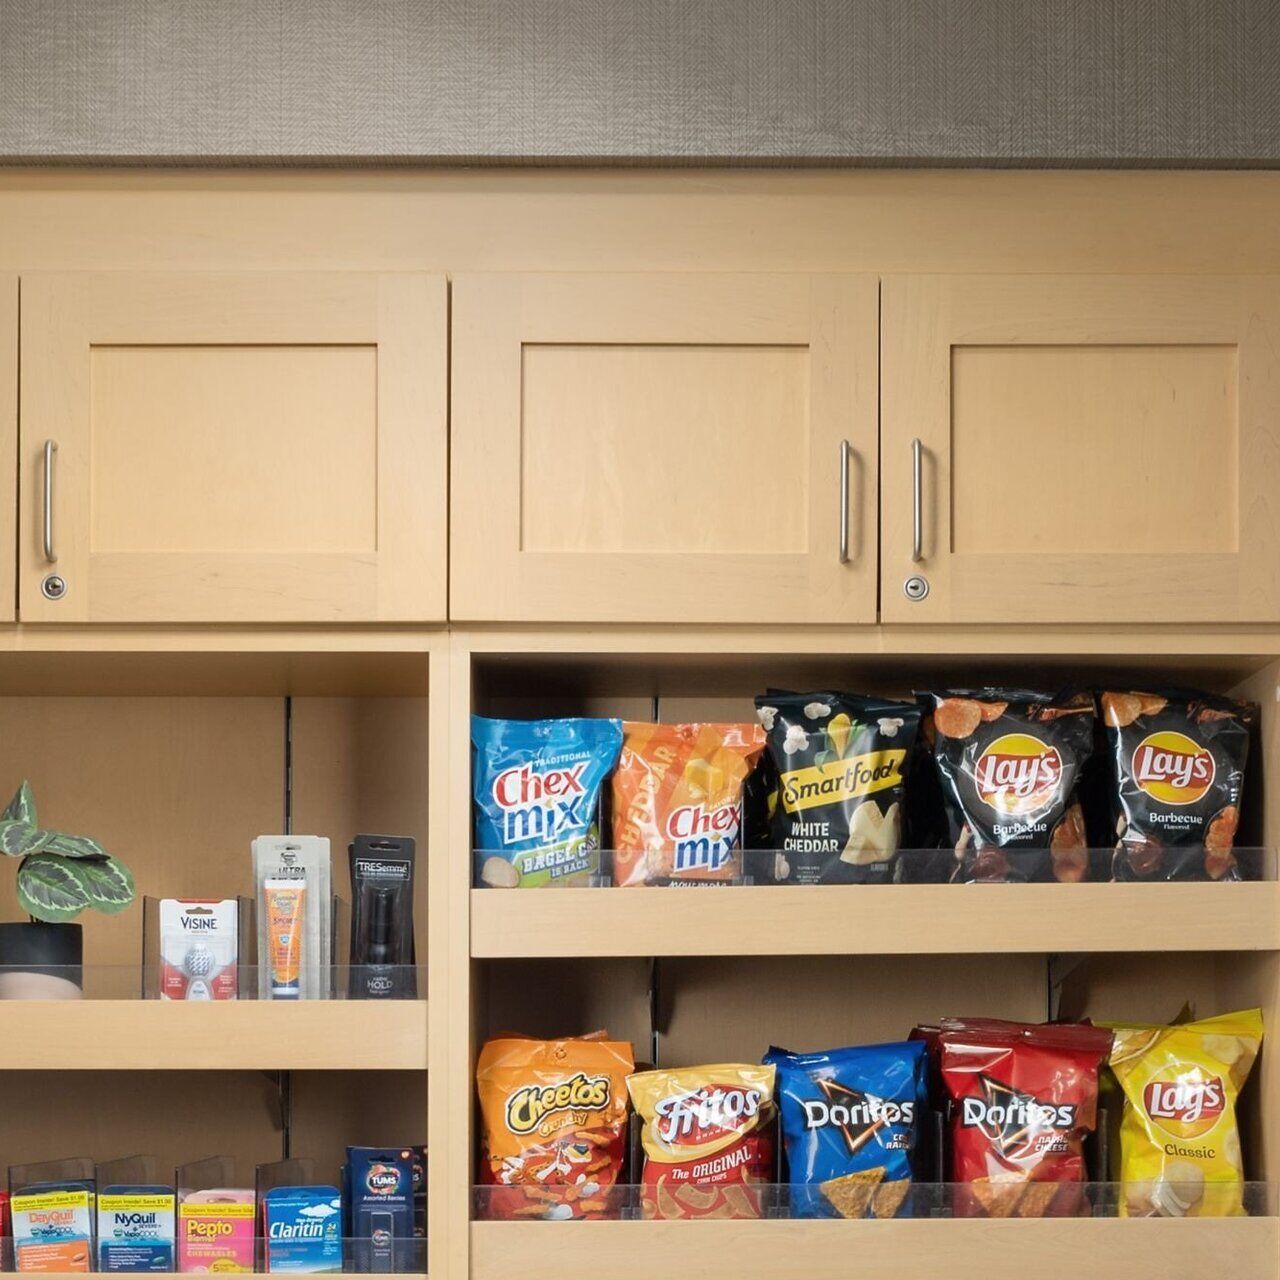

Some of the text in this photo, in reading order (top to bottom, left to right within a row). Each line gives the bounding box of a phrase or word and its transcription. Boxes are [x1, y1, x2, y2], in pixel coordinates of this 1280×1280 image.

[535, 751, 591, 767] TRADITIONAL
[982, 752, 1057, 796] Lay's
[1139, 746, 1209, 790] Lay's
[495, 763, 586, 807] Chex
[785, 759, 895, 804] Smartfood
[616, 746, 676, 864] CHEDDAR
[668, 803, 742, 838] Chex
[1149, 812, 1204, 825] Barbecue
[791, 822, 830, 837] WHITE
[993, 822, 1048, 835] Barbecue
[784, 838, 839, 853] CHEDDAR
[357, 861, 408, 873] TRESemmé
[522, 848, 576, 874] BAGEL
[278, 866, 306, 874] ULTRA
[181, 917, 218, 930] VISINE
[367, 980, 393, 990] HOLD
[508, 1074, 609, 1133] Cheetos
[1150, 1080, 1220, 1122] Lay's
[655, 1087, 761, 1143] Fritos
[807, 1101, 914, 1128] Doritos
[964, 1097, 1073, 1126] Doritos
[539, 1112, 587, 1136] Crunchy
[1164, 1144, 1216, 1159] Classic
[672, 1147, 751, 1180] The ORIGINAL
[372, 1176, 396, 1185] TUMS
[29, 1210, 74, 1225] DayQuil
[115, 1213, 155, 1226] NyQuil
[187, 1220, 233, 1236] Pepto
[270, 1222, 323, 1238] Claritin
